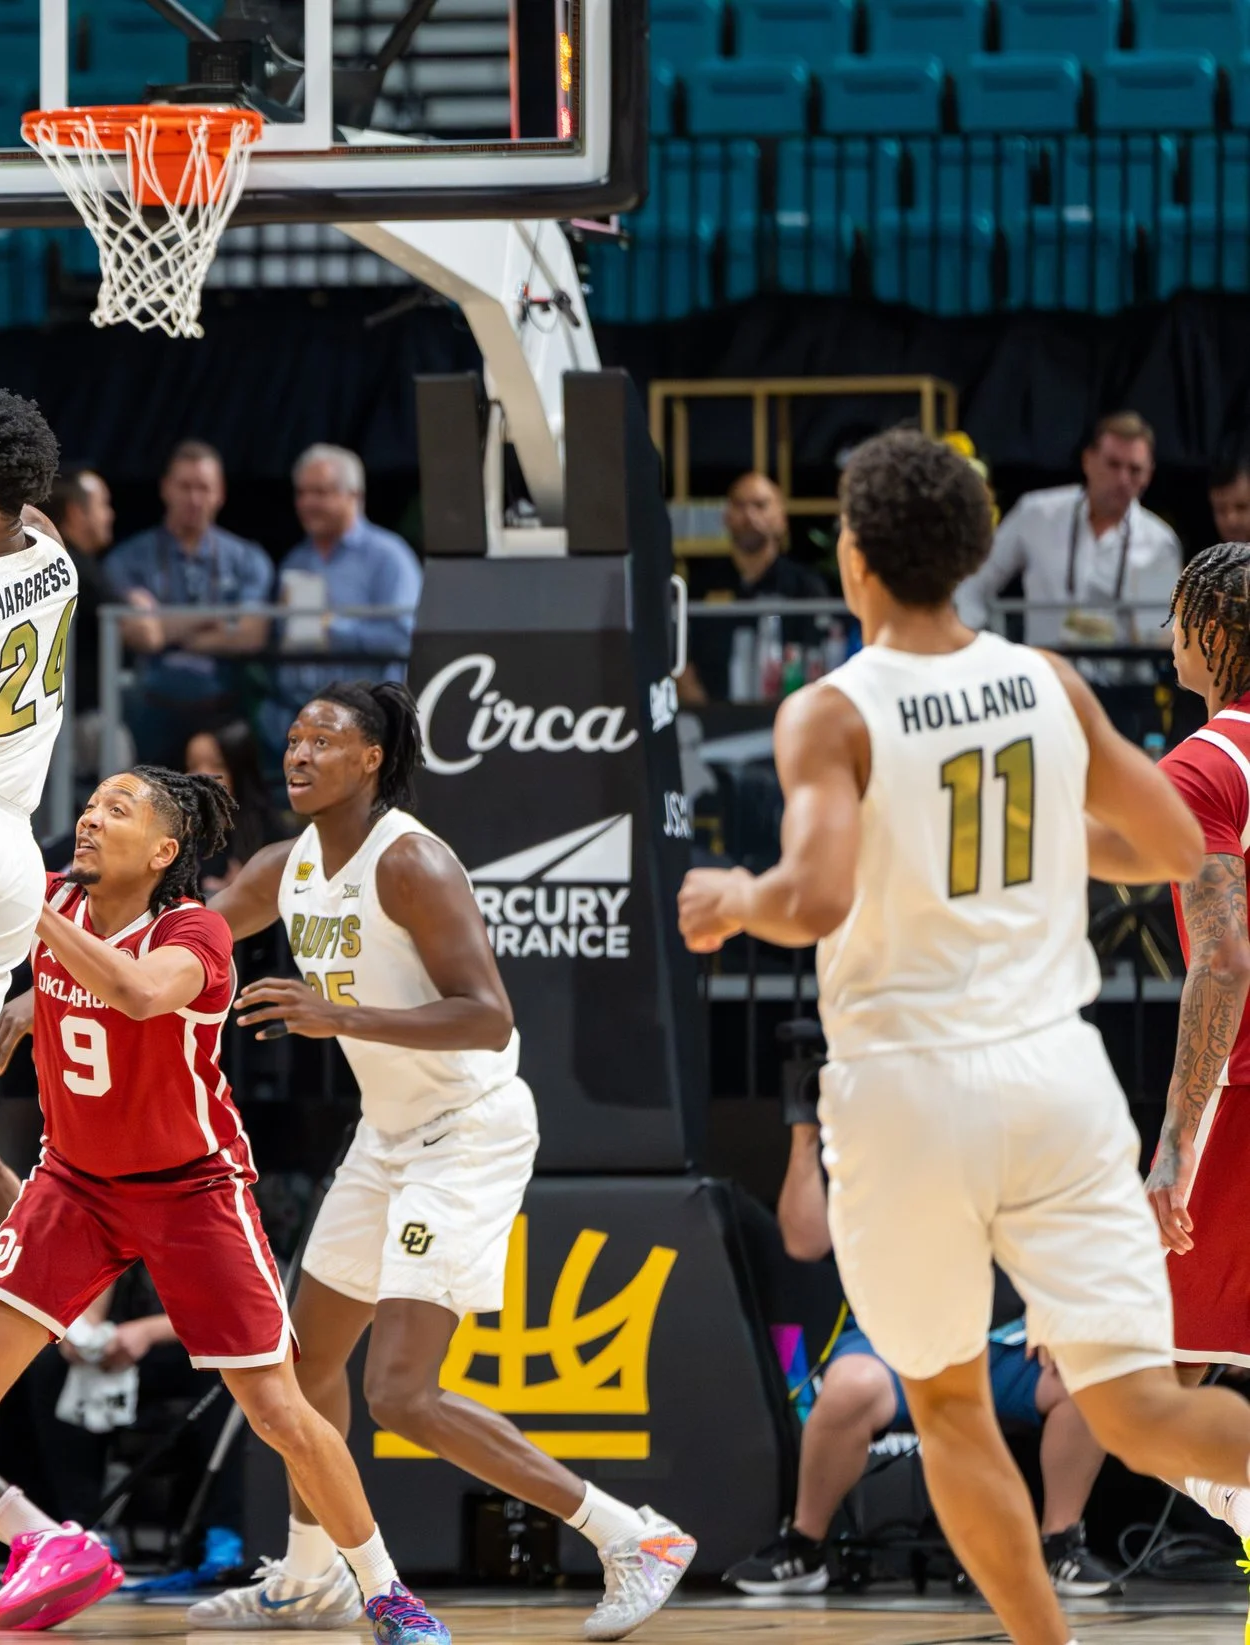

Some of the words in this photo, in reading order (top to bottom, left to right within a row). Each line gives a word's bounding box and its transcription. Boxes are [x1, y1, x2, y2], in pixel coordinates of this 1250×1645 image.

[416, 653, 639, 776] Circa
[897, 674, 1037, 734] HOLLAND
[940, 735, 1035, 899] 11
[474, 886, 631, 926] RCURY
[487, 924, 631, 958] RANCE
[59, 1014, 112, 1098] 9
[400, 1221, 435, 1257] CU
